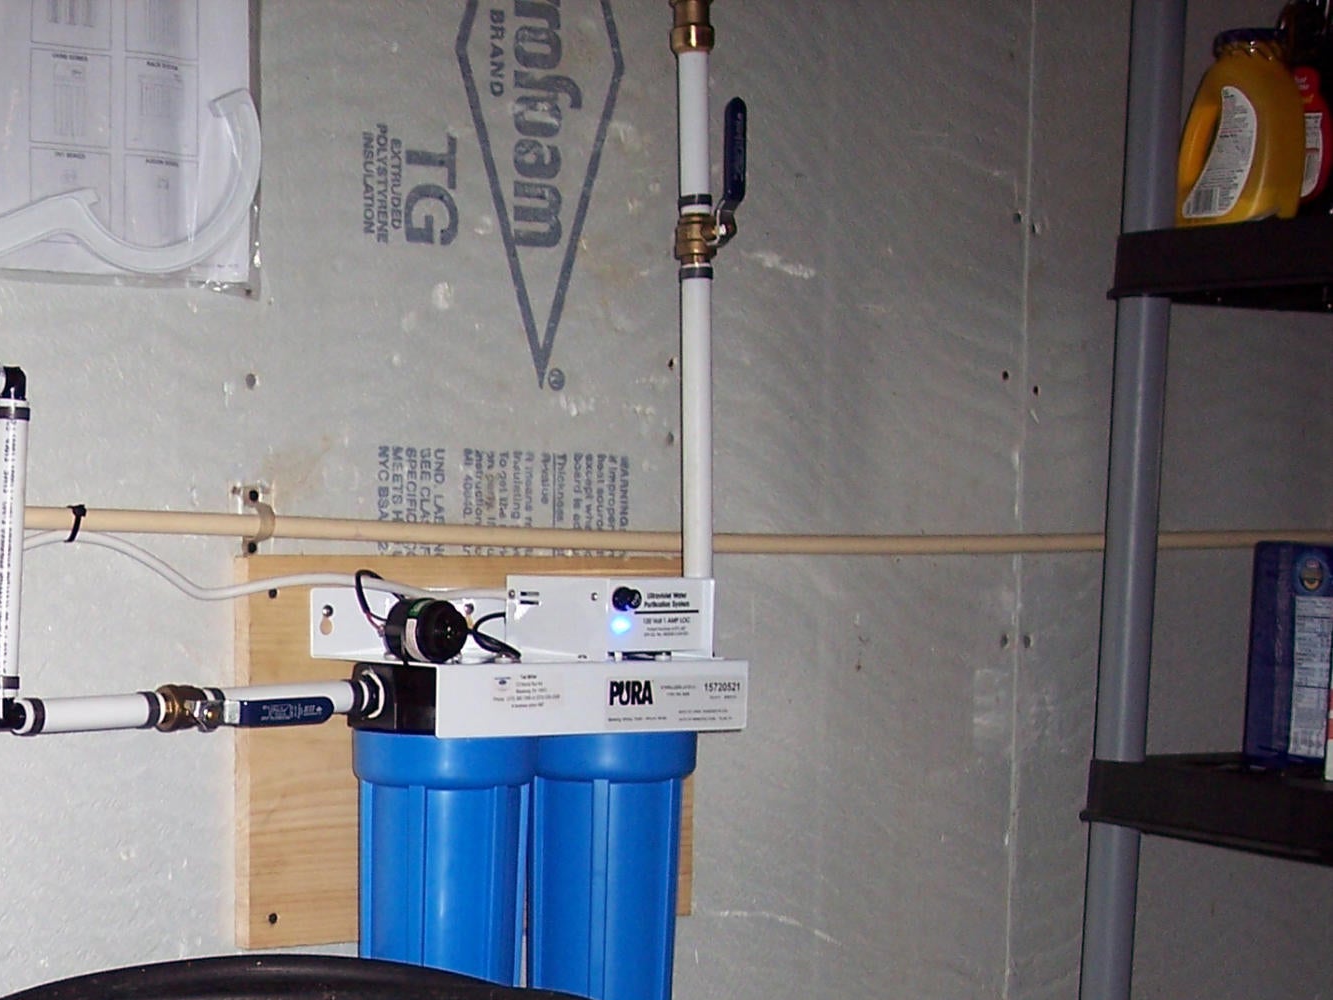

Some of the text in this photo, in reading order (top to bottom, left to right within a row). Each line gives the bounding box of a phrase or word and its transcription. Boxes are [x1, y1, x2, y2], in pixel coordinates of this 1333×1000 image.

[490, 9, 505, 97] BRAND
[514, 0, 582, 248] rofoam
[362, 131, 375, 234] INSULATION
[376, 123, 388, 244] POLYSTYRENE
[390, 138, 402, 230] EXTRUDED
[405, 132, 459, 246] TG
[378, 446, 389, 482] NYC
[392, 446, 403, 504] MEETS
[420, 448, 431, 481] SEE
[557, 454, 567, 522] Thickness
[609, 680, 653, 706] PURA
[705, 682, 740, 692] 15720521
